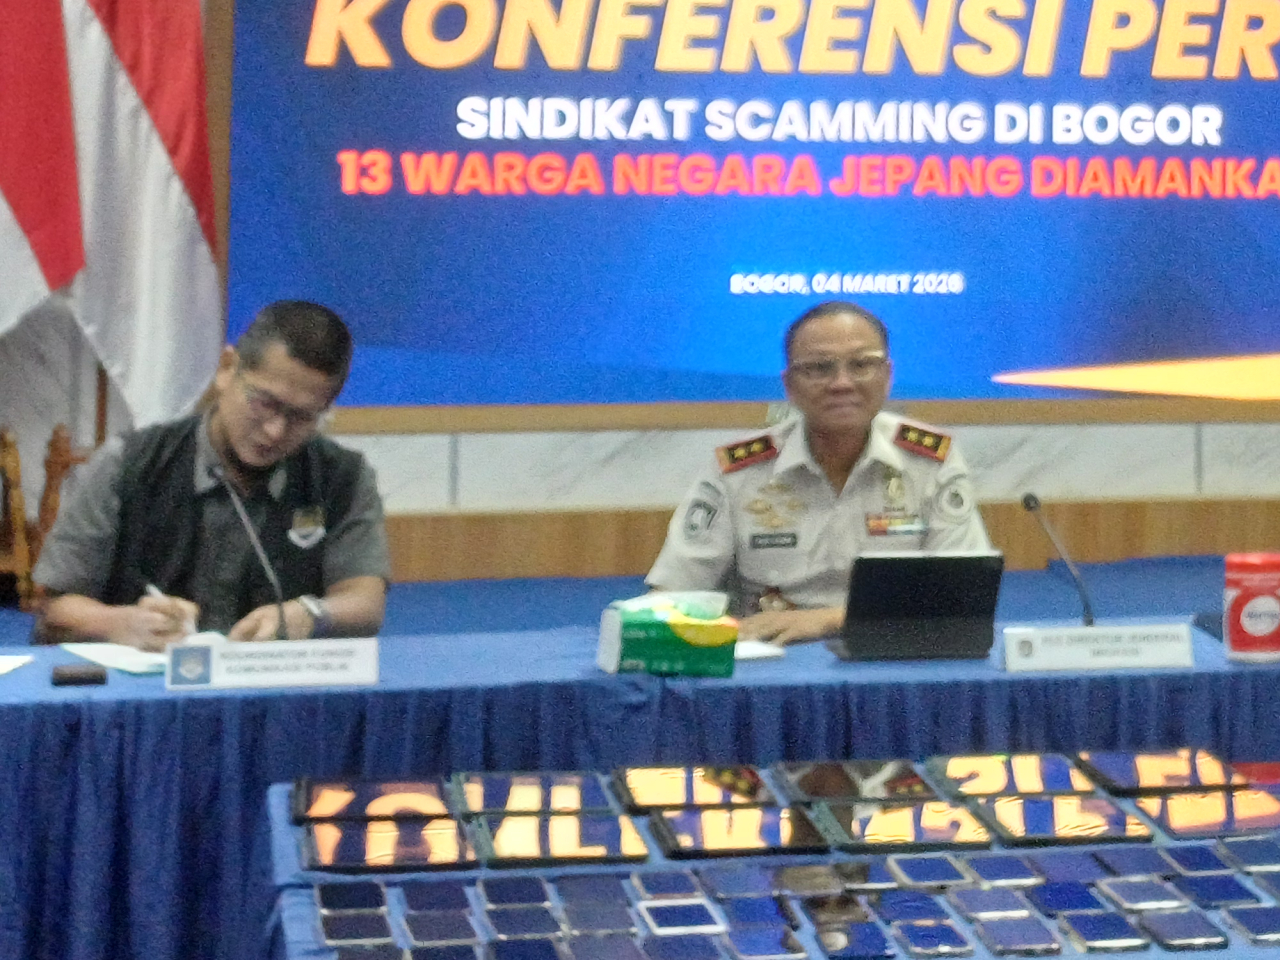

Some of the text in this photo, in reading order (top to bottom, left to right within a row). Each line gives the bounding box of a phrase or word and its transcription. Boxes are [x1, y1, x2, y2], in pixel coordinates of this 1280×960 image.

[456, 96, 1223, 146] SINDIKAT SCAMMING DI BOGOR
[337, 149, 393, 196] 13
[400, 151, 605, 196] WARGA
[612, 153, 820, 197] NEGARA
[829, 155, 1023, 198] JEPANG
[730, 273, 809, 295] BOGOR,
[811, 273, 840, 294] 04
[842, 274, 911, 295] MARET
